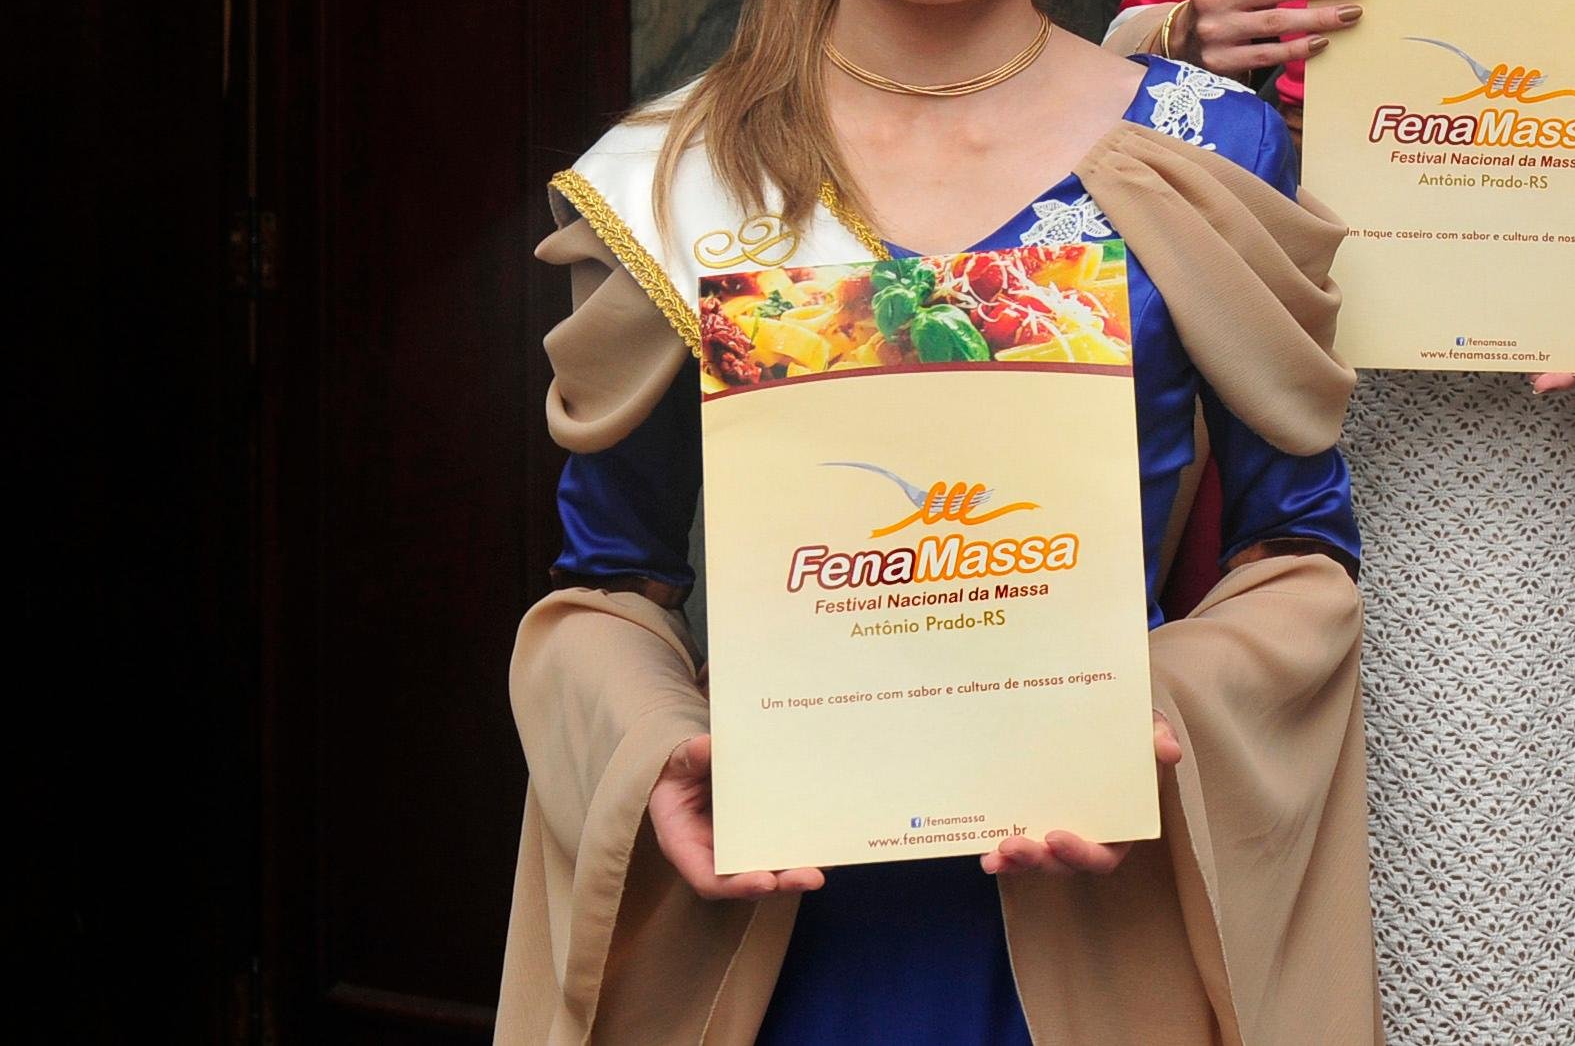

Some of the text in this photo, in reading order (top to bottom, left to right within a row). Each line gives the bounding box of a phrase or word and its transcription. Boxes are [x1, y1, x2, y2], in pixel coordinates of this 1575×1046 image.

[1391, 151, 1447, 165] Festival
[1451, 152, 1515, 167] Nacional
[1518, 155, 1537, 167] da
[1418, 173, 1548, 189] Antônio Prado-RS
[1363, 229, 1393, 240] toque
[1396, 229, 1433, 239] caseiro
[1436, 232, 1458, 240] com
[1462, 230, 1490, 241] sabor
[1502, 232, 1539, 243] cultura
[1542, 234, 1555, 243] de
[1421, 349, 1551, 362] www.fenamassa.com.br
[787, 534, 1079, 593] FenaMassa
[815, 582, 1049, 615] Festival Nacional da Massa
[850, 610, 1006, 638] Antônio Prado-RS
[761, 671, 1117, 710] Um toque caseiro com sabor e cultura de nossas origens.
[868, 825, 1027, 848] www.fenamassa.com.br
